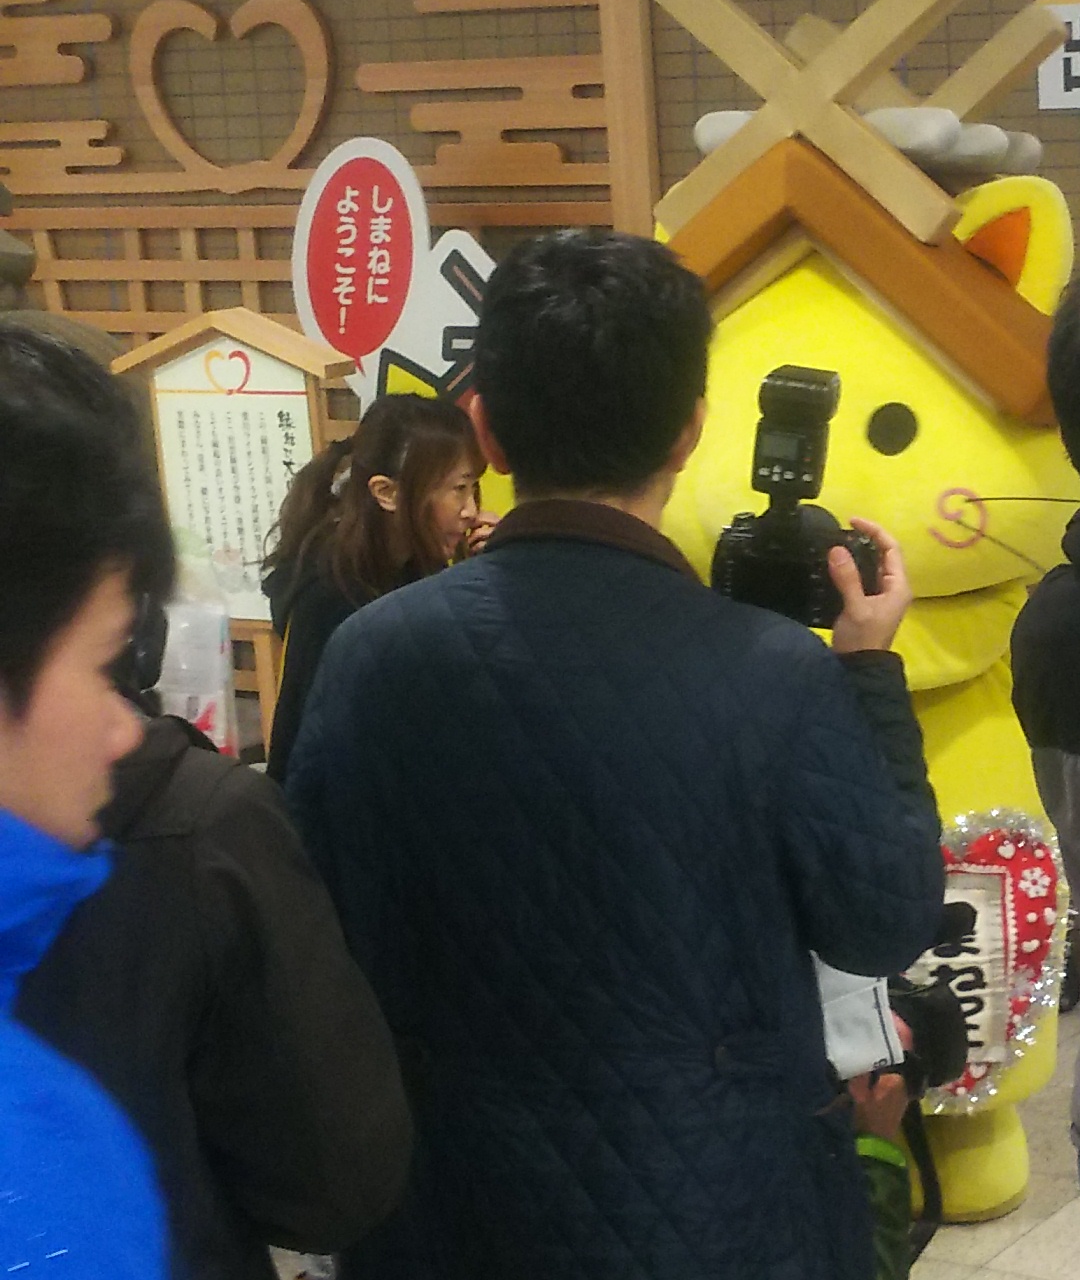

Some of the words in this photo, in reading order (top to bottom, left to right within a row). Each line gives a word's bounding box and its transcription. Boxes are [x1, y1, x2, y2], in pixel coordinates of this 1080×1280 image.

[332, 185, 360, 334] ようこそ!
[367, 185, 393, 305] しまねに
